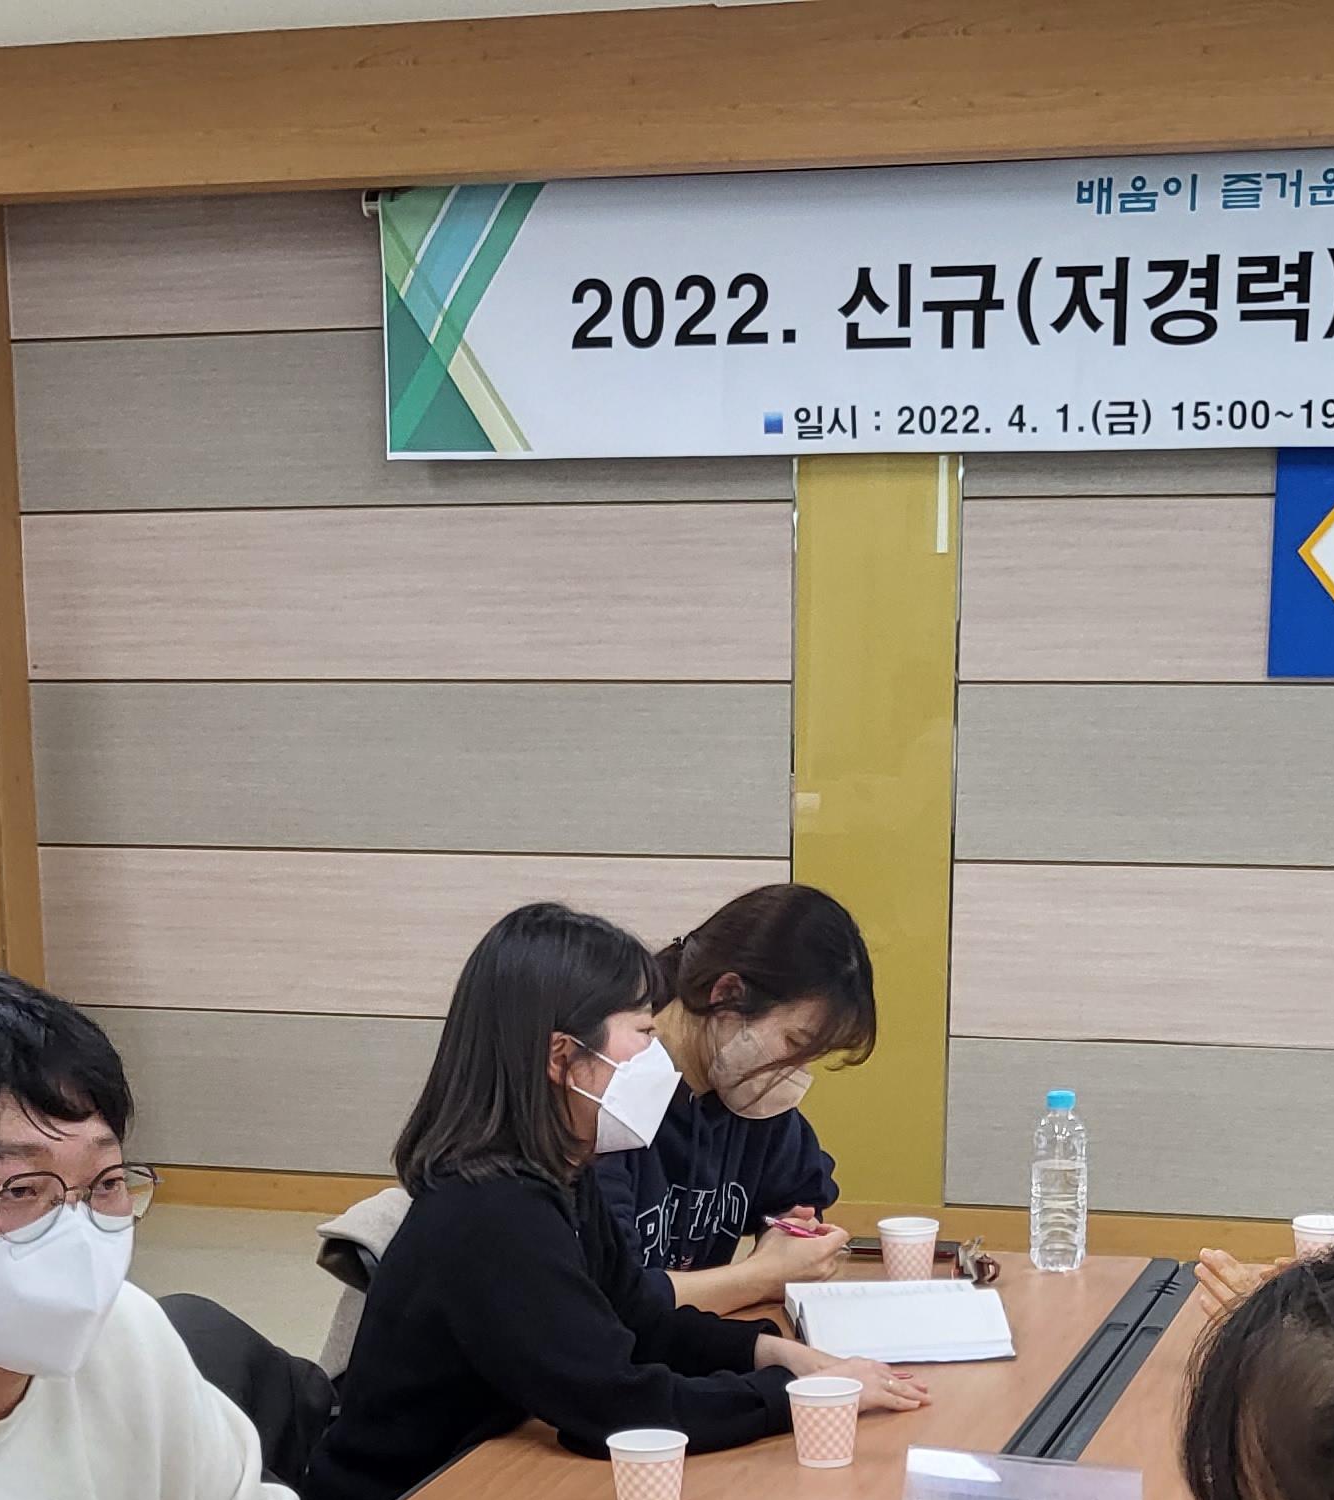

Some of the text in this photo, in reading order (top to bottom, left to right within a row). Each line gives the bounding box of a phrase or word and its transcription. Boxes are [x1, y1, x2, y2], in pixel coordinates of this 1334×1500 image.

[1075, 173, 1199, 215] 배움이
[570, 272, 798, 351] 2022.
[793, 405, 858, 441] 일시
[896, 404, 992, 436] 2022.
[1006, 403, 1039, 434] 4.
[1055, 398, 1154, 437] 1.(금)
